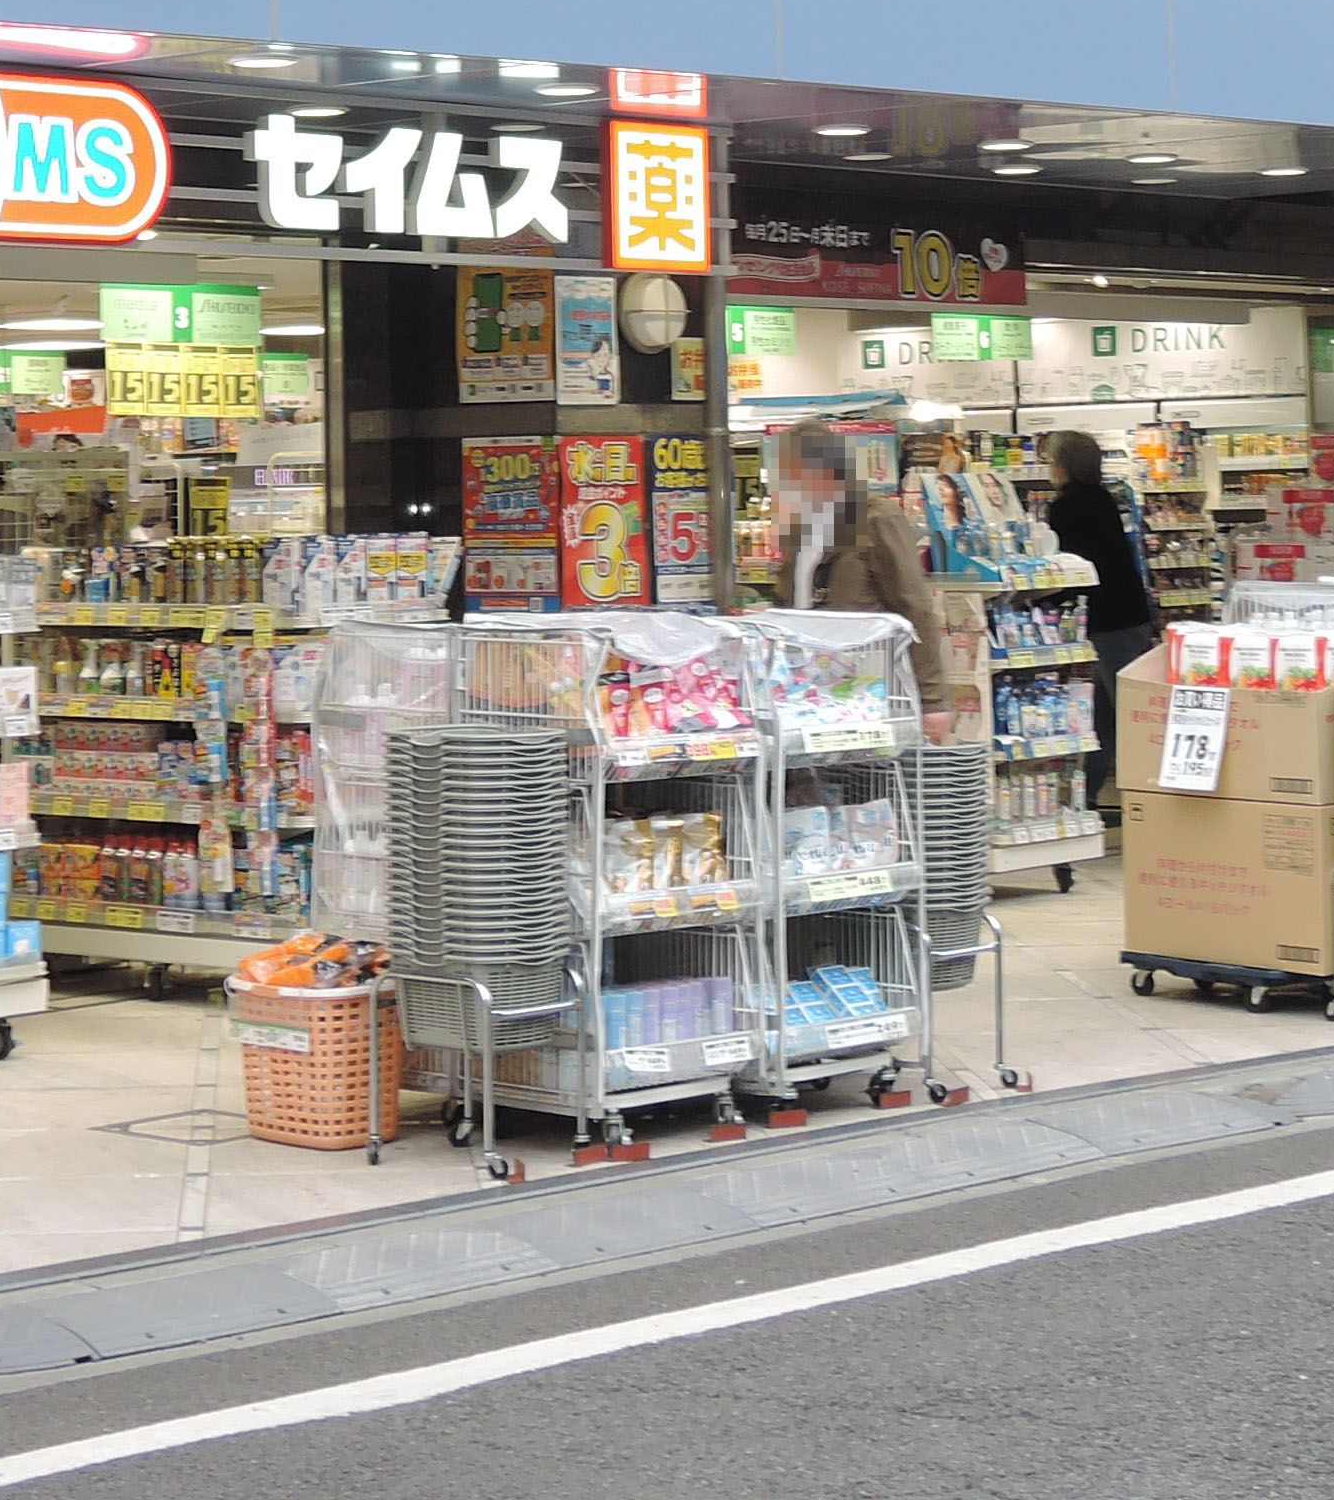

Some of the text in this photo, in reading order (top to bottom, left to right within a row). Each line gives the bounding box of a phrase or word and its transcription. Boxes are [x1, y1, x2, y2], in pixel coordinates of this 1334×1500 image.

[251, 112, 569, 245] セイムス
[624, 141, 699, 250] 薬
[174, 306, 190, 330] 3
[731, 322, 744, 342] 5
[1130, 324, 1228, 353] DRINK
[109, 371, 144, 402] 15
[149, 372, 181, 404] 15
[186, 374, 219, 405] 15
[224, 374, 256, 405] 15
